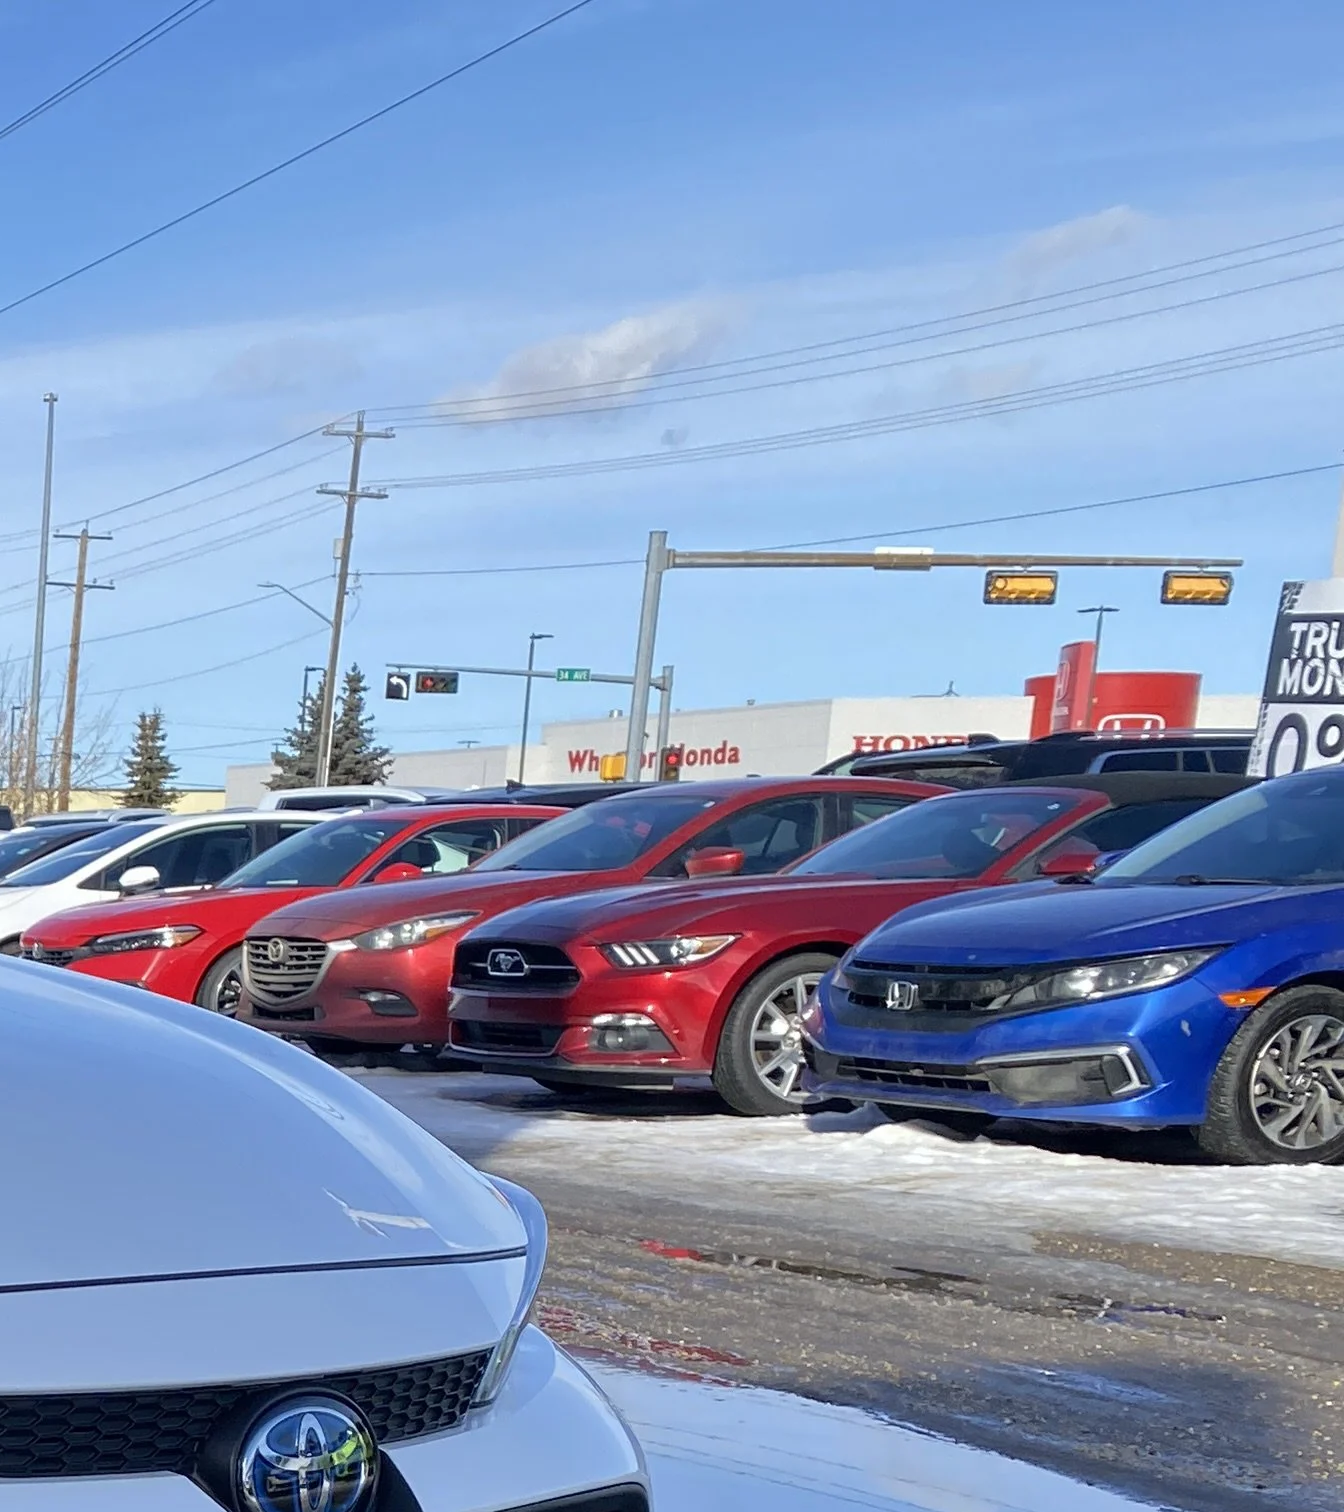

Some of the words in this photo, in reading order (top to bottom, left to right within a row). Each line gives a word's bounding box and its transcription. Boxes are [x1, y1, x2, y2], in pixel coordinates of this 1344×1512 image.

[1289, 621, 1344, 660] TRU
[559, 670, 569, 680] 34
[573, 670, 588, 680] AVE
[1276, 658, 1344, 697] MON
[852, 735, 969, 754] HON
